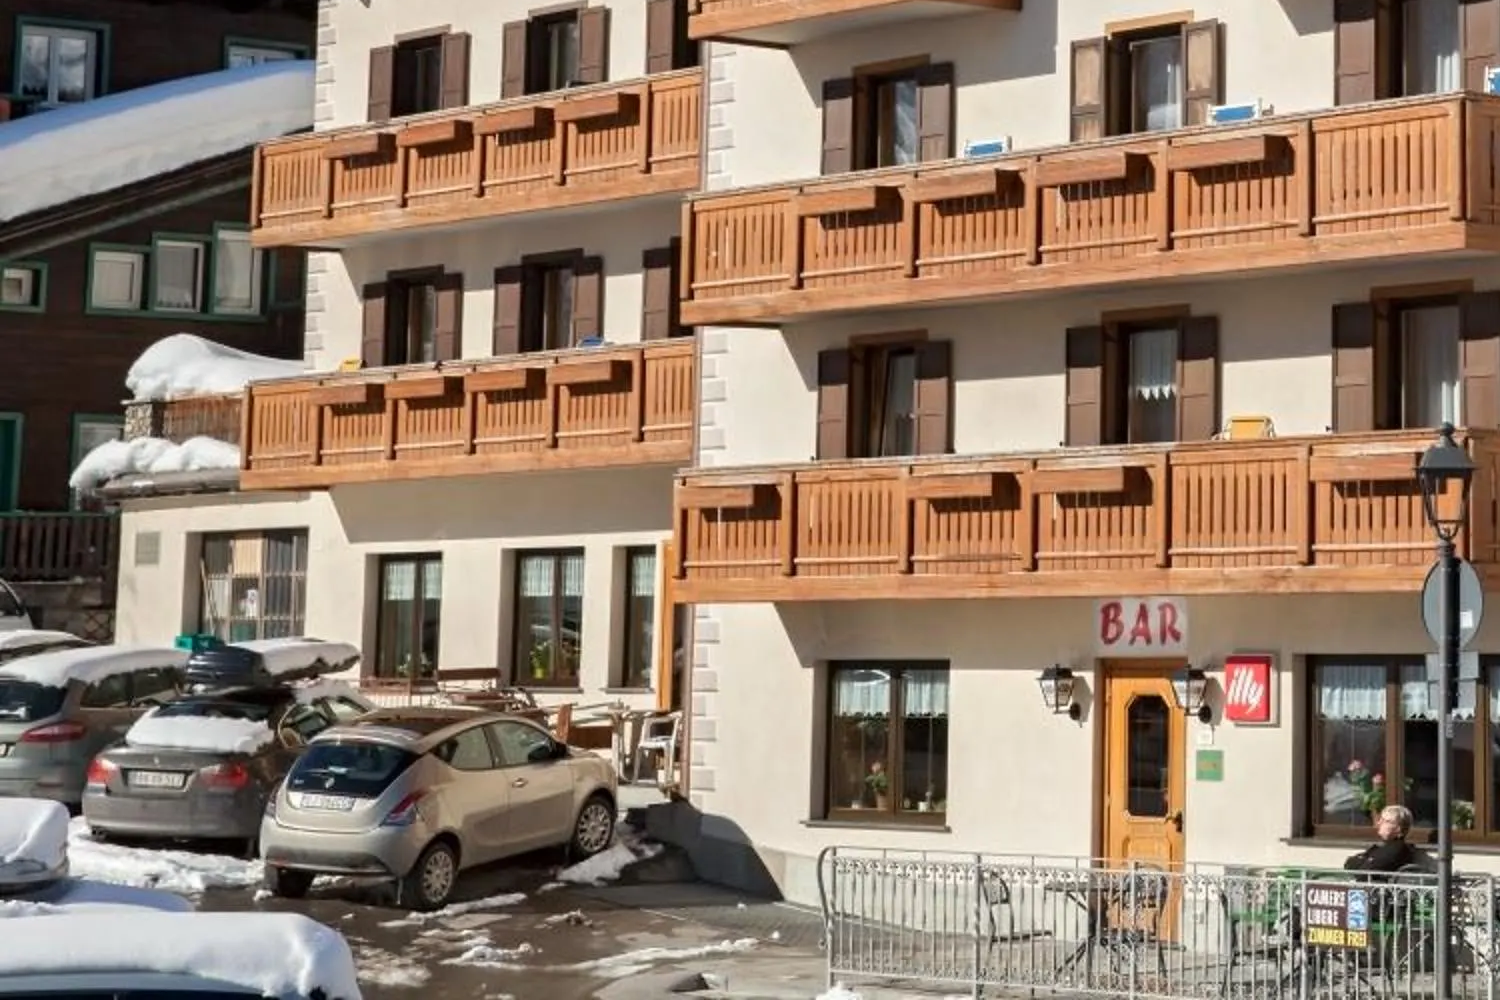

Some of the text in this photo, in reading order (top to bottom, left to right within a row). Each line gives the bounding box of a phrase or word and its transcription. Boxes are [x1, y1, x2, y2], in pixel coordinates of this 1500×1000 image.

[1101, 602, 1181, 646] BAR
[1227, 663, 1266, 716] illy
[1307, 887, 1346, 907] CAMERE
[1307, 907, 1339, 926] LIBERE
